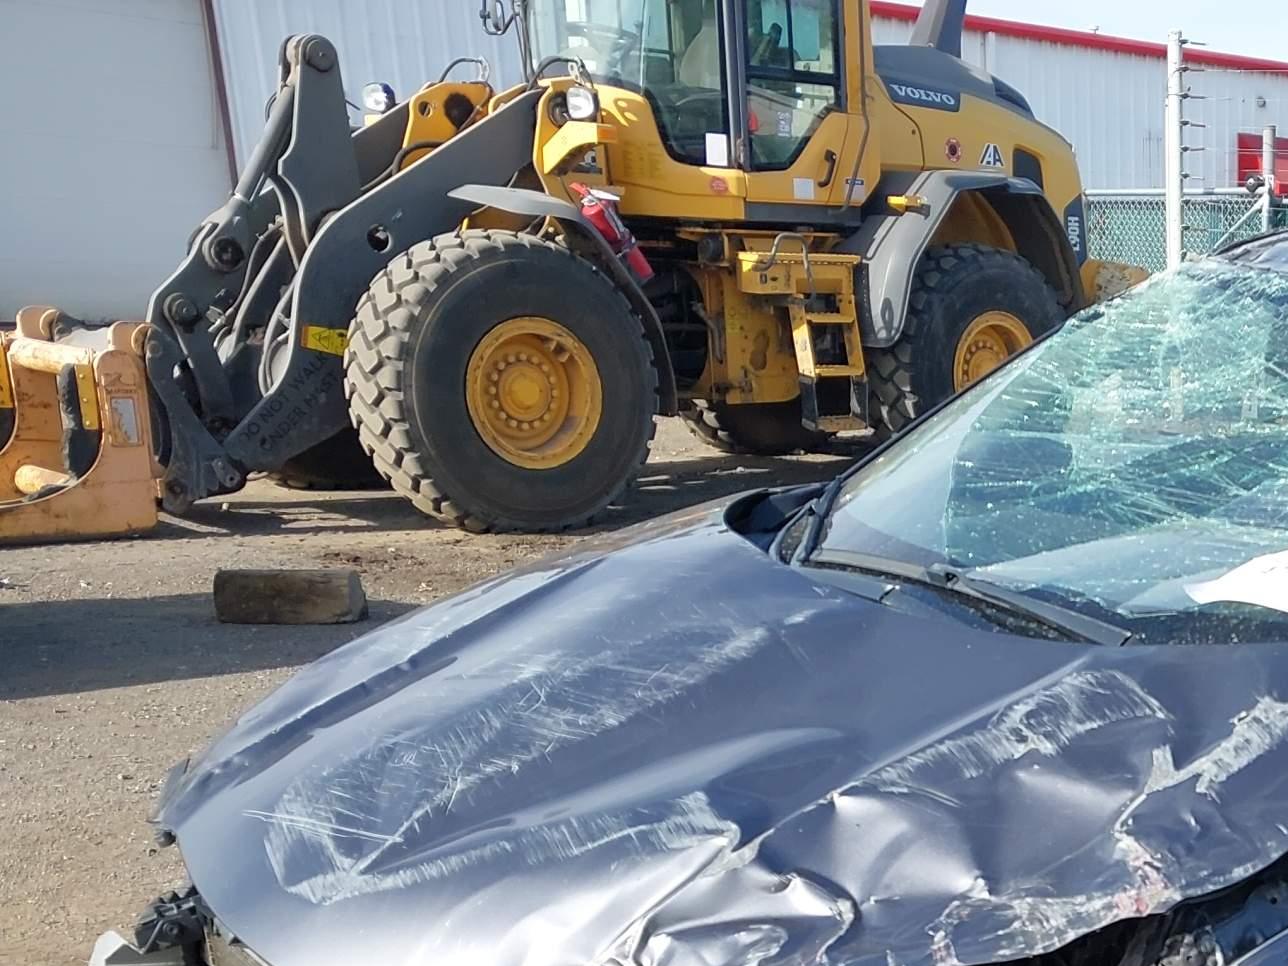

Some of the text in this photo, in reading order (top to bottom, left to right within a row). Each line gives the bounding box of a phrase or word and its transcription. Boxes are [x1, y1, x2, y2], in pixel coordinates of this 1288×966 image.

[889, 83, 955, 105] VOLVO
[1067, 216, 1080, 251] L90H
[259, 390, 290, 421] NOT
[287, 353, 328, 392] WALK
